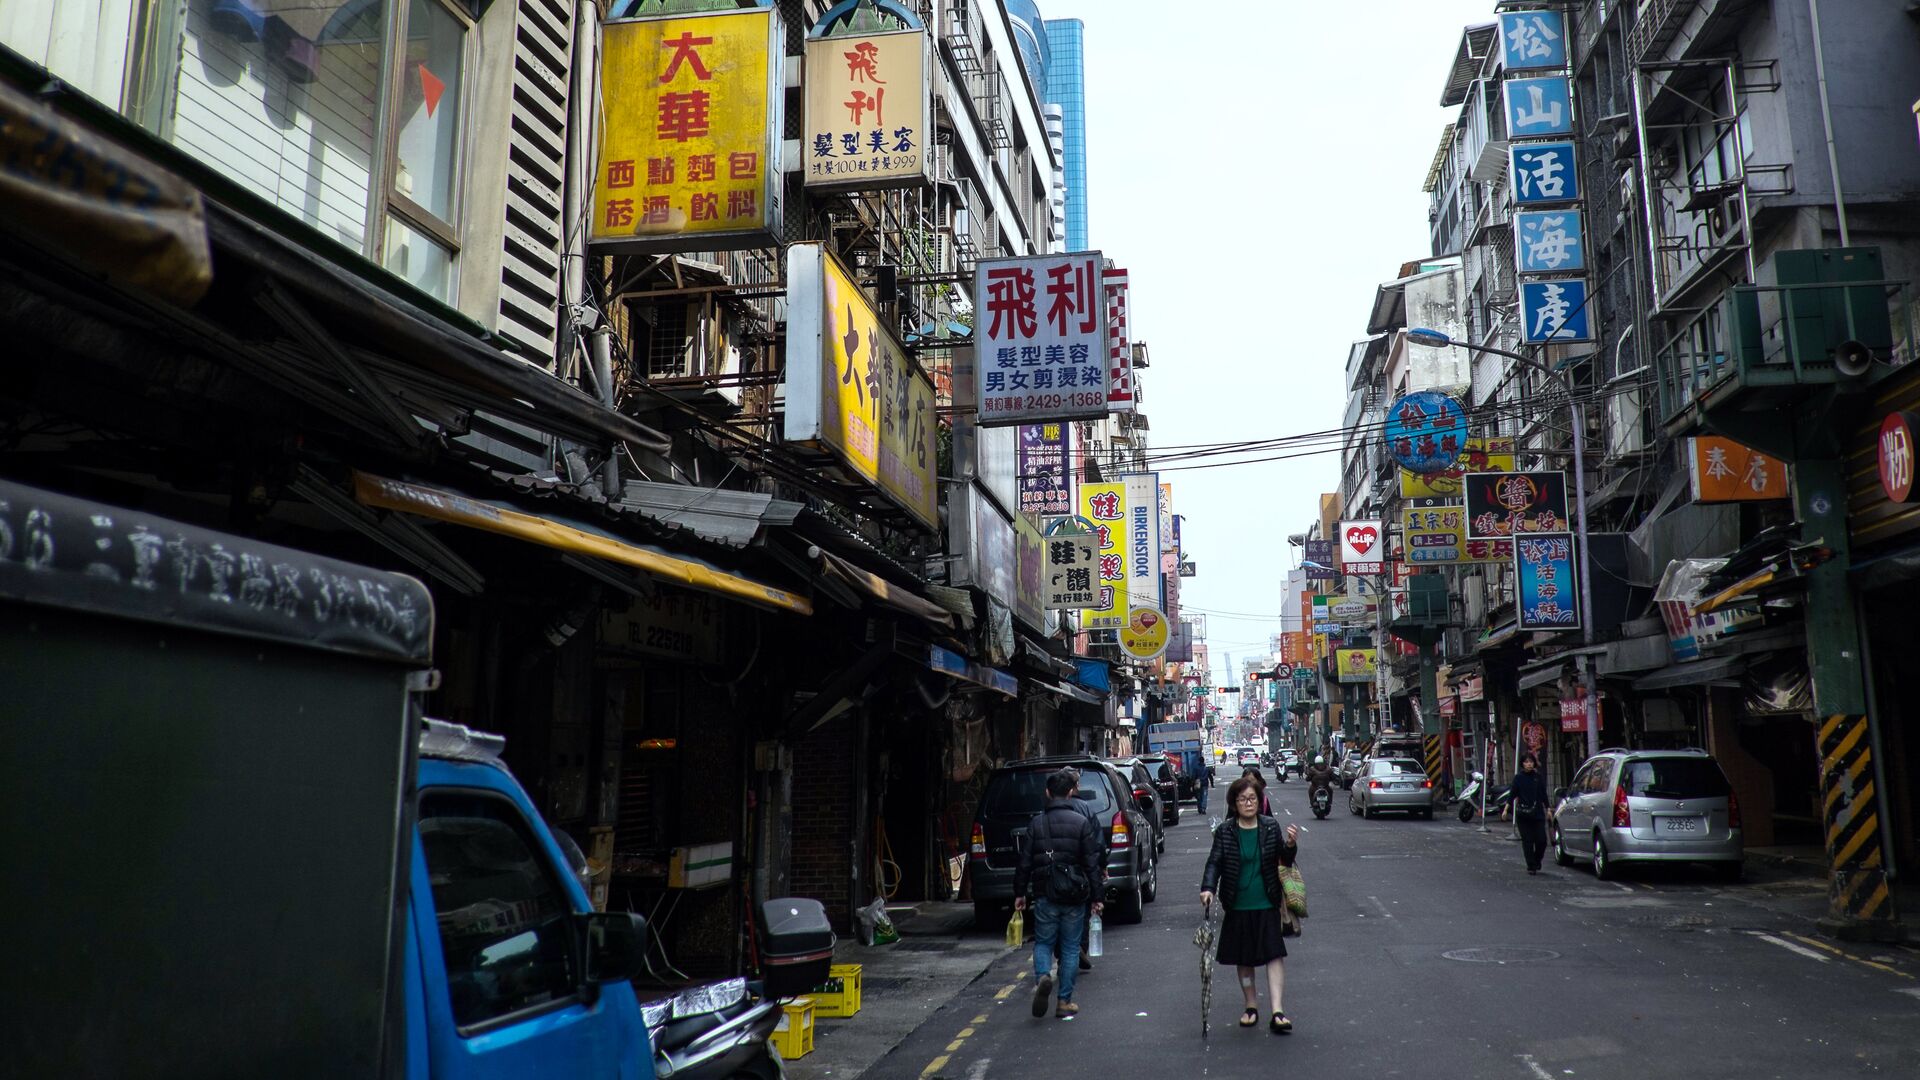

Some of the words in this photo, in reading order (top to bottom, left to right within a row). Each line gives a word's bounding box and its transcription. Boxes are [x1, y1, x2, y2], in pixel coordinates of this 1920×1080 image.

[657, 31, 713, 143] 大華
[844, 41, 887, 127] 飛利
[813, 126, 917, 158] 髮型美容
[607, 152, 757, 190] 西點麵包
[605, 189, 757, 228] 菸酒飲料
[986, 260, 1097, 341] 飛利
[996, 343, 1089, 368] 髮型美容
[985, 365, 1102, 392] 男女剪燙染
[1407, 511, 1464, 532] 正宗奶
[1134, 506, 1148, 578] BIRKENSTOCK
[1349, 532, 1375, 547] Hi-Life
[1525, 543, 1567, 563] 松山
[1053, 592, 1093, 604] 流行鞋坊
[1536, 563, 1561, 619] 活海鮮
